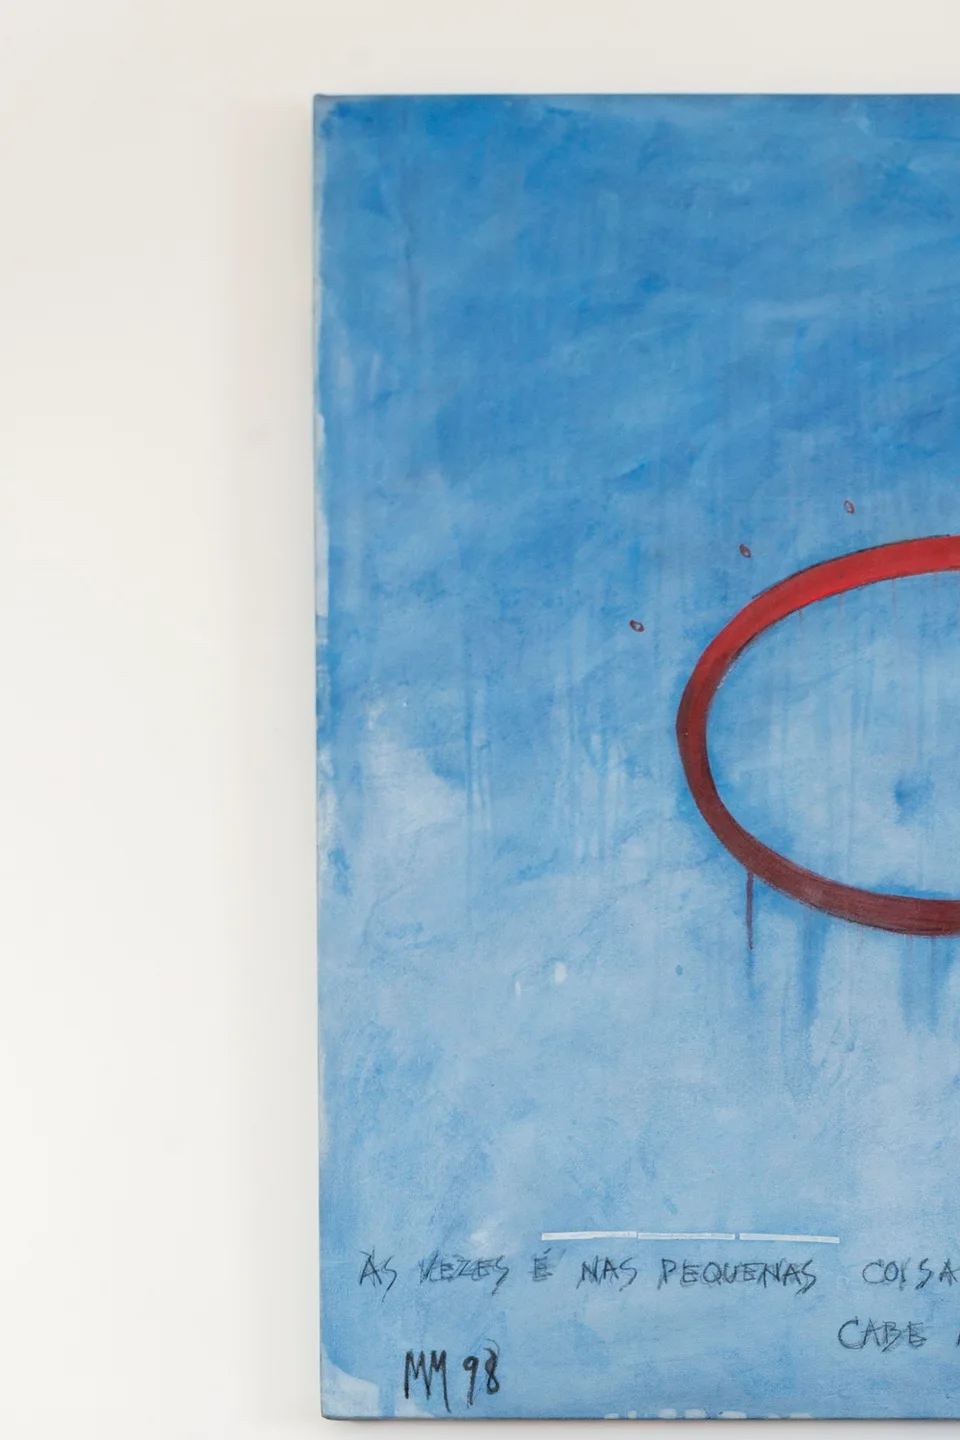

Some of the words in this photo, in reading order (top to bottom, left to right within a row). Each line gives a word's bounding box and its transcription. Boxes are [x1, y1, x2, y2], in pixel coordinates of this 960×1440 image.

[419, 1250, 509, 1296] VEZES
[530, 1248, 554, 1282] É
[577, 1257, 637, 1291] NAS
[657, 1257, 817, 1294] PEQUENAS
[463, 1339, 500, 1408] 98
